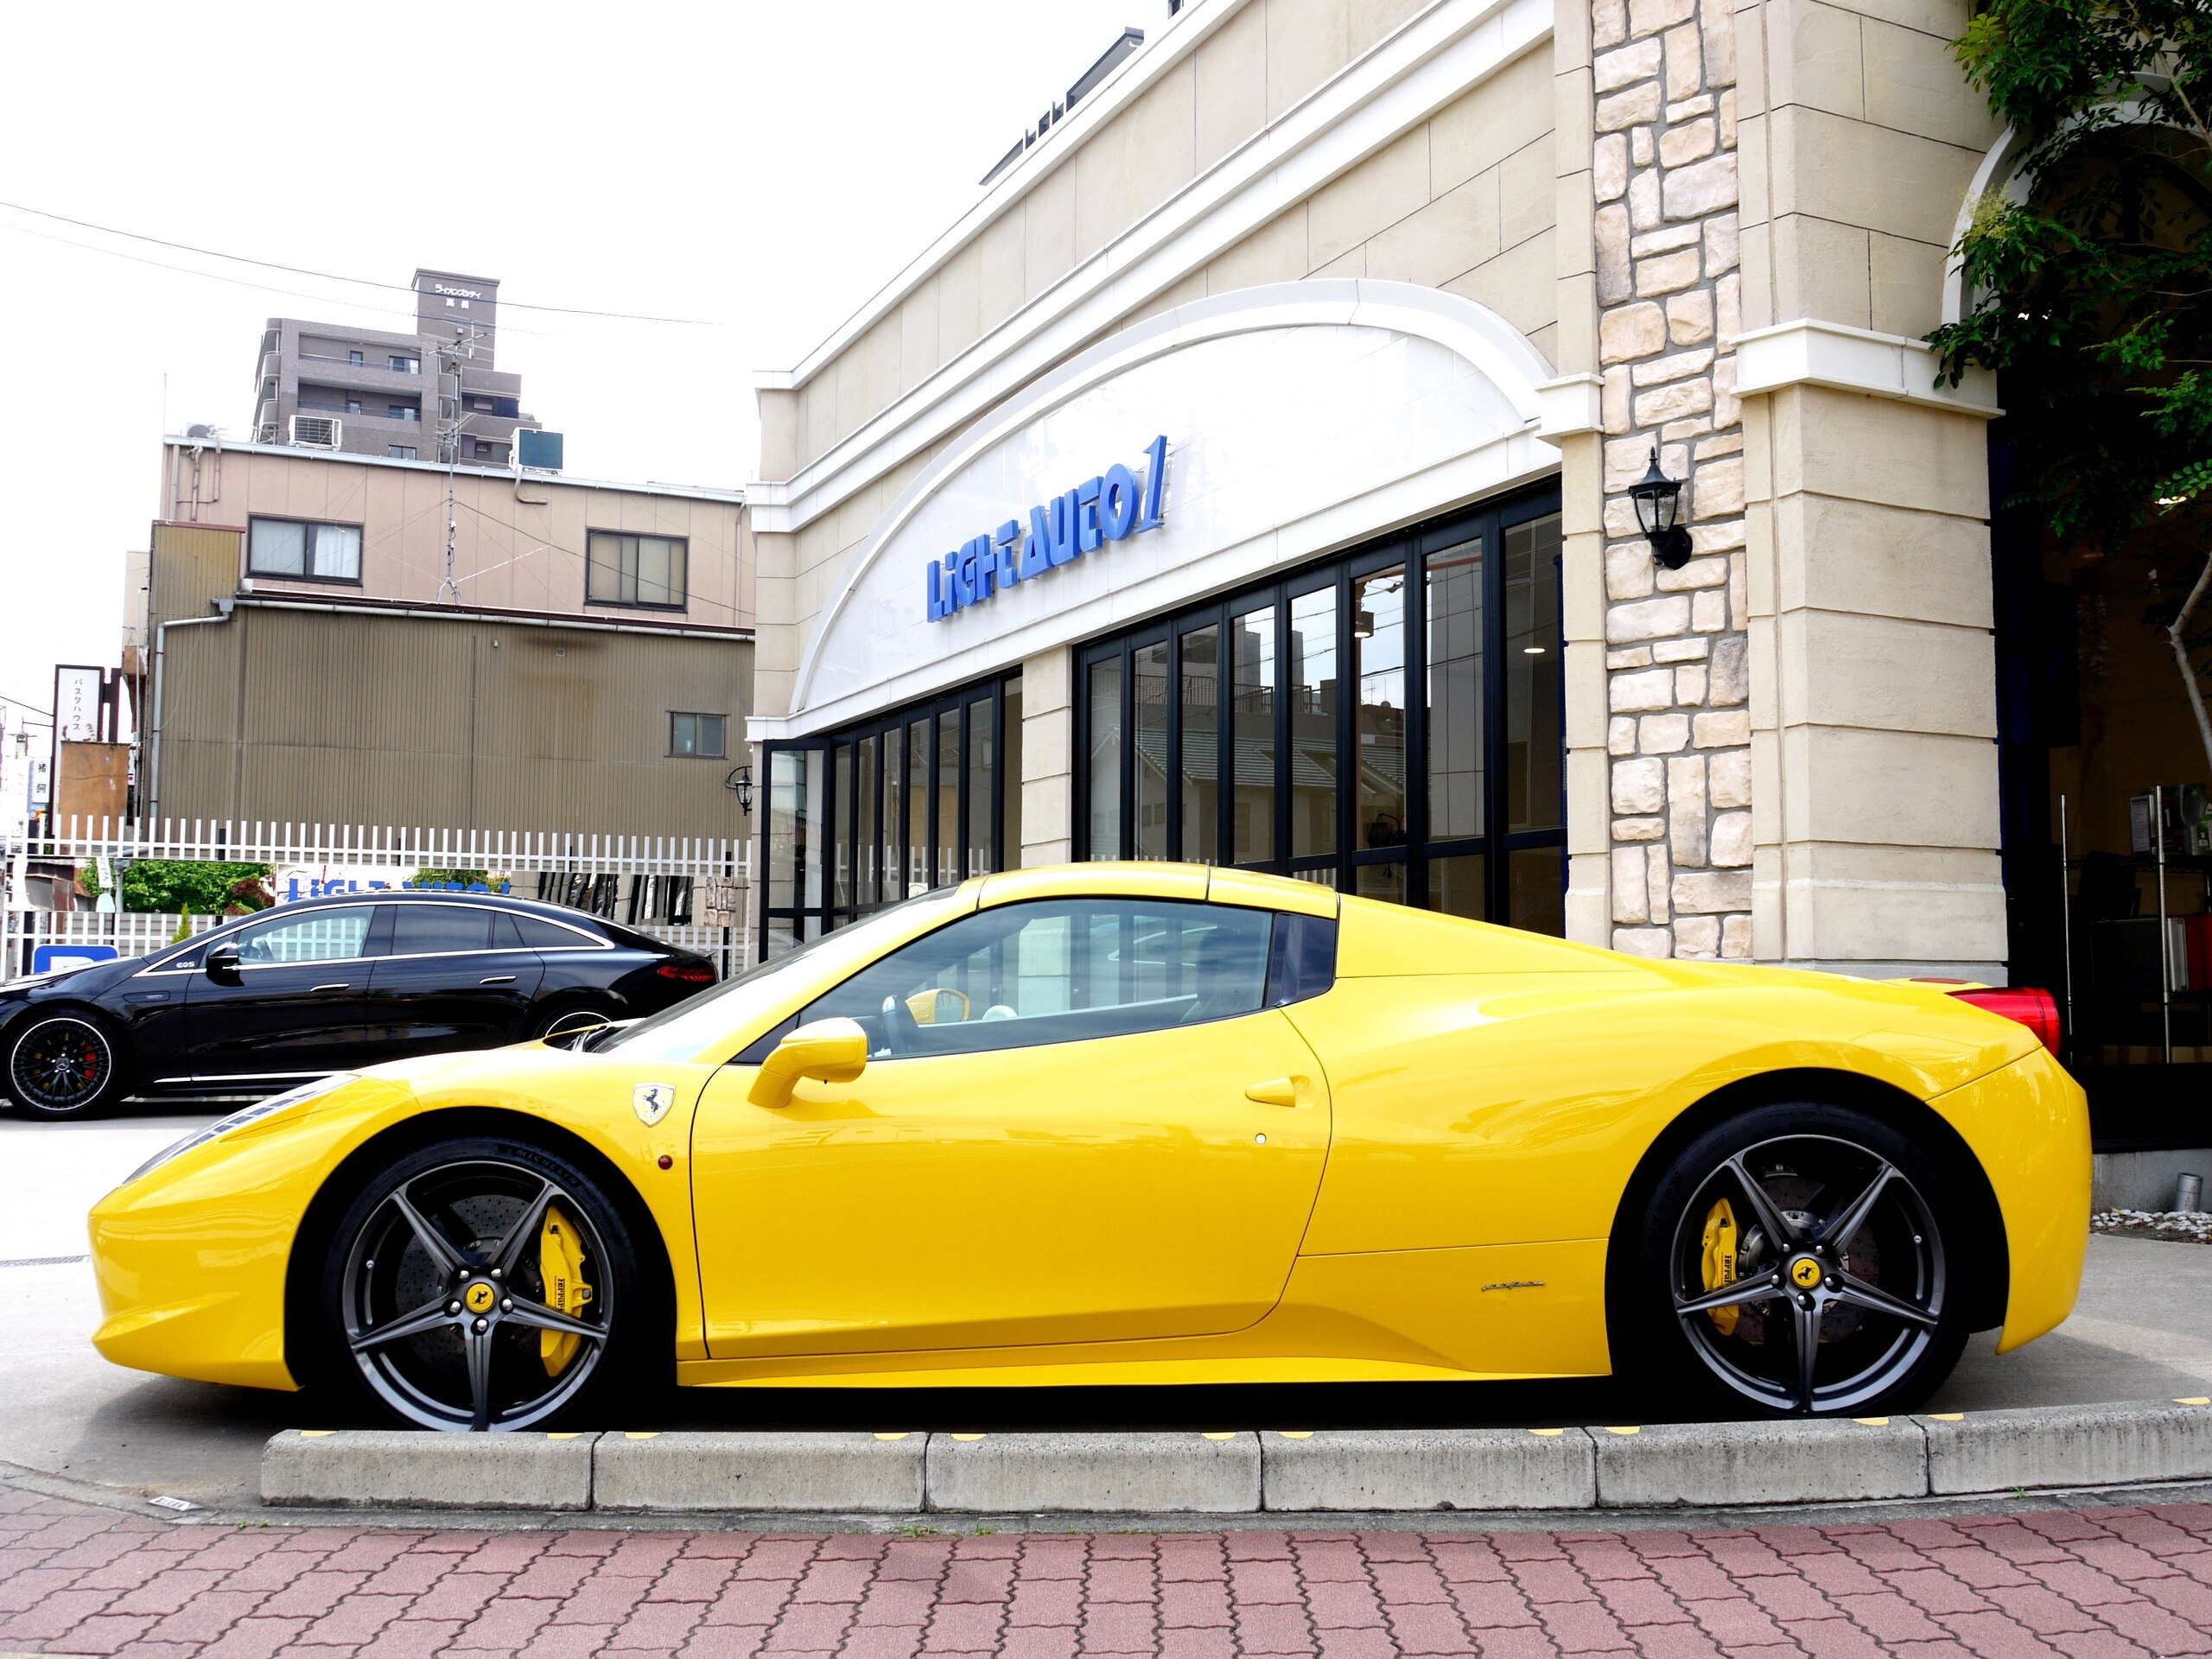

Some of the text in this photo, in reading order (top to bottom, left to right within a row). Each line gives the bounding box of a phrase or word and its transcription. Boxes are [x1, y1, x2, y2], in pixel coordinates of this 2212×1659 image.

[73, 678, 84, 730] パスタハウス
[517, 1148, 579, 1185] MICHELIN
